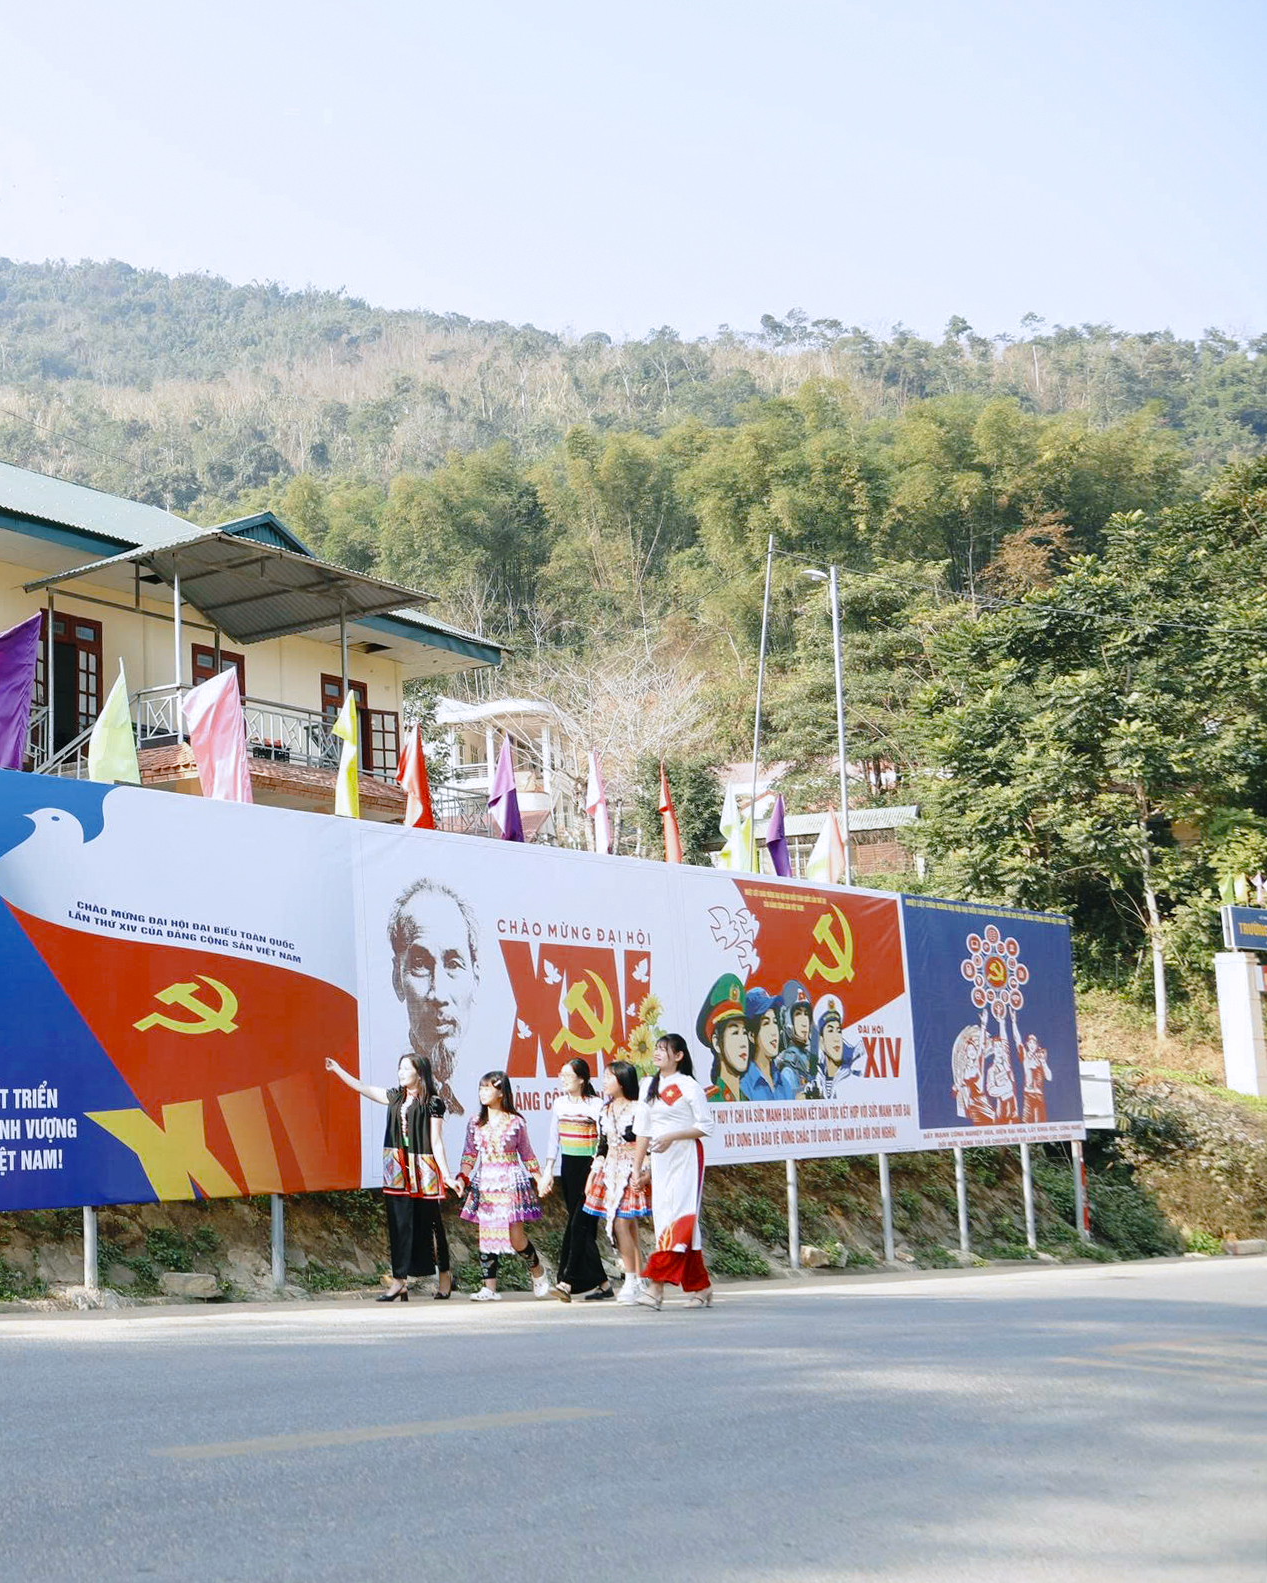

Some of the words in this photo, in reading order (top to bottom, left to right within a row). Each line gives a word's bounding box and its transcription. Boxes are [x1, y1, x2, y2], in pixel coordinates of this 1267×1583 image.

[69, 910, 90, 923] LẦN
[94, 917, 116, 928] THỨ
[119, 923, 137, 932] XIV
[141, 925, 163, 937] CỦA
[167, 930, 197, 941] ĐẢNG
[200, 935, 229, 947] CỘNG
[232, 941, 253, 952] SẢN
[256, 946, 276, 957] VIỆT
[279, 951, 301, 964] NAM
[77, 901, 107, 915] CHÀO
[111, 909, 145, 922] MỪNG
[149, 916, 167, 927] ĐẠI
[171, 919, 189, 930] HỘI
[192, 922, 210, 933] ĐẠI
[214, 925, 237, 937] BIỂU
[240, 931, 266, 943] TOÀN
[269, 937, 295, 950] QUỐC
[497, 918, 542, 936] CHÀO
[548, 922, 591, 940] MỪNG
[597, 928, 621, 946] ĐẠI
[627, 928, 651, 948] HỘI
[862, 1037, 901, 1078] XIV
[13, 1081, 58, 1109] TRIỂN
[511, 1085, 540, 1110] ẢNG
[25, 1117, 77, 1143] VƯỢNG
[21, 1149, 63, 1170] NAM!
